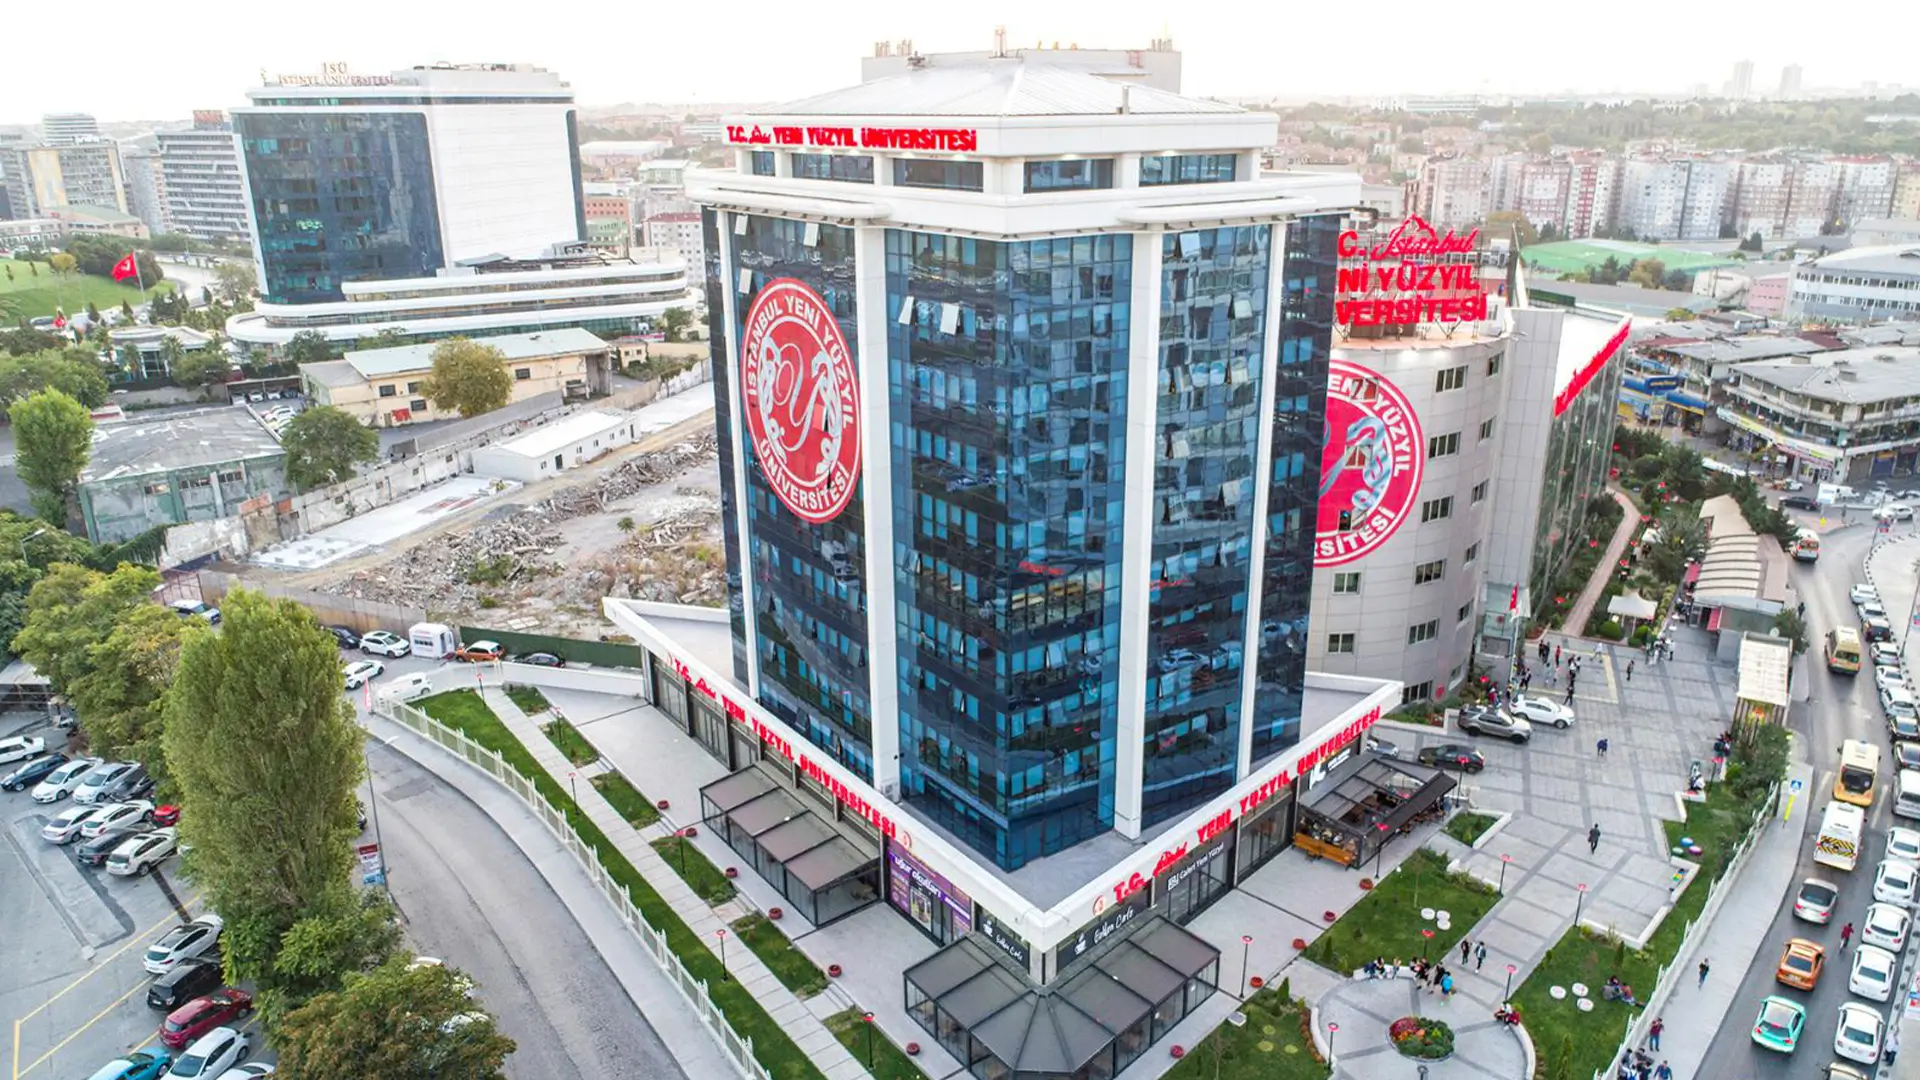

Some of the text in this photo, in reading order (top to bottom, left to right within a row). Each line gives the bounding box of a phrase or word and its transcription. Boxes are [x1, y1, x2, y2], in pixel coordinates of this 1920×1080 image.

[726, 125, 748, 143] T.C.
[806, 126, 859, 147] YÜZYIL
[860, 127, 977, 152] ÜNİVERSİTESİ
[1337, 230, 1367, 258] C.
[1337, 259, 1481, 294] Nİ YÜZYIL
[1335, 291, 1488, 326] VERSİTESİ
[784, 295, 821, 331] YENİ
[823, 324, 854, 430] YÜZYIL
[1373, 393, 1411, 478] YÜZYIL
[760, 438, 850, 511] ÜNİVERSİTESİ
[799, 753, 897, 841] ÜNİVERSİTESİ
